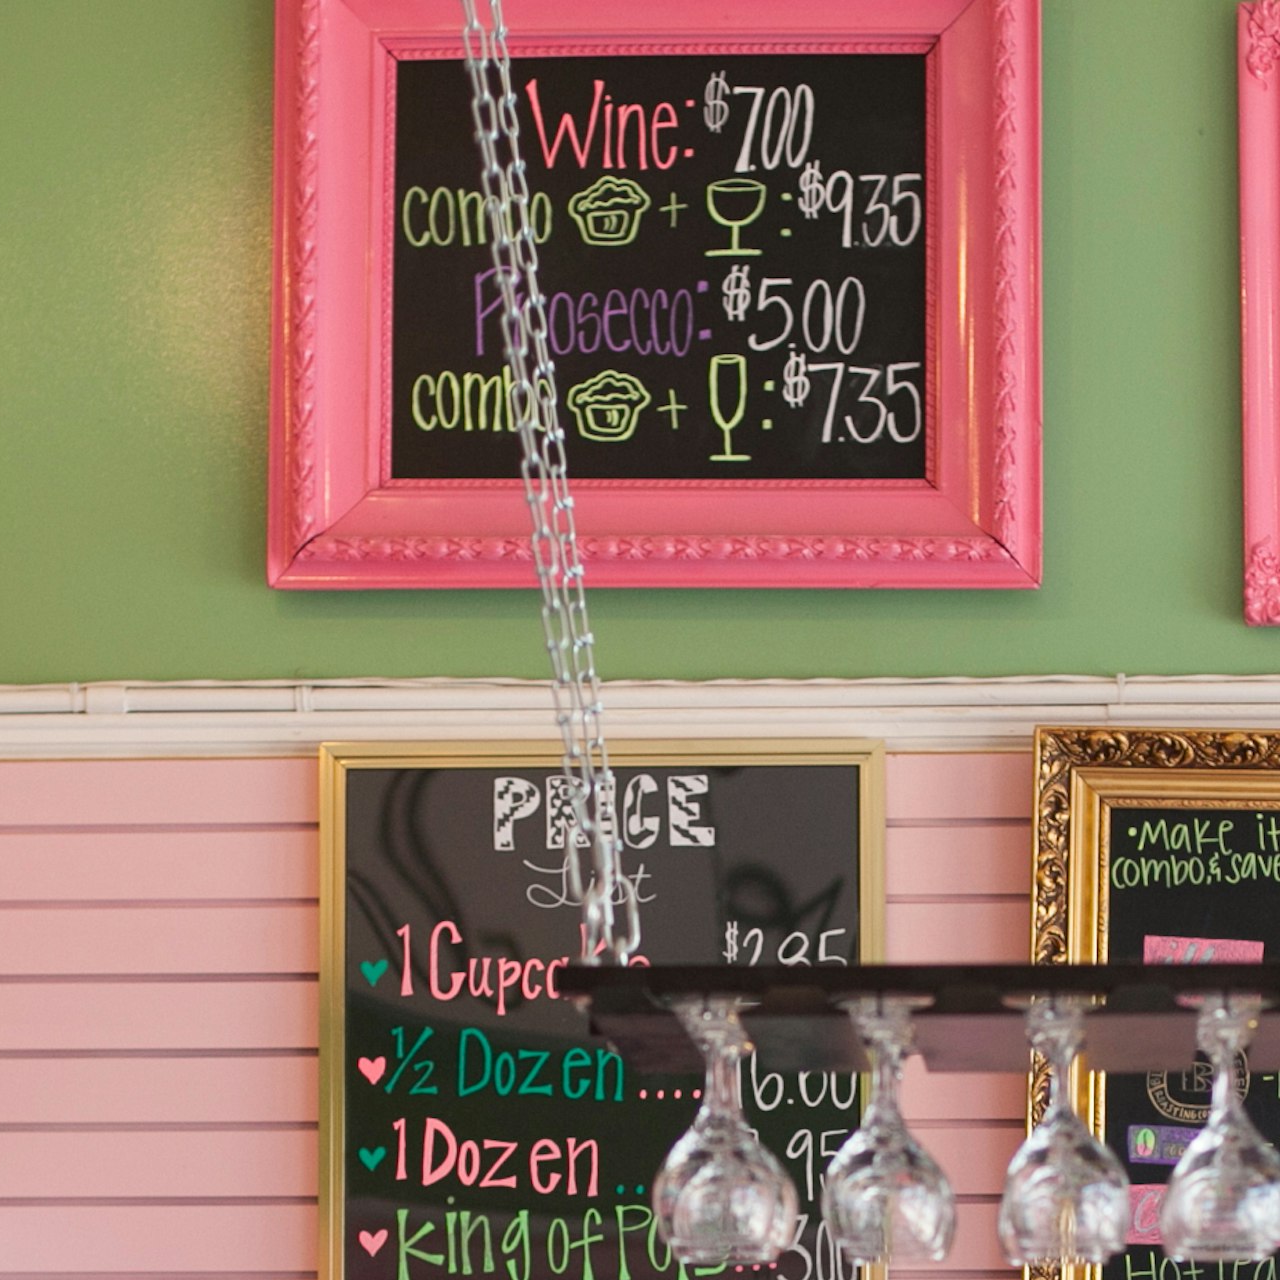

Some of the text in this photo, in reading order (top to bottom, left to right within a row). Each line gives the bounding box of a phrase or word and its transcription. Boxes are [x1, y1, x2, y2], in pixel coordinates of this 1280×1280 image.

[525, 79, 695, 170] Wine:
[492, 773, 716, 852] PRICE
[457, 1027, 624, 1103] Dozen
[421, 1117, 600, 1198] Dozen
